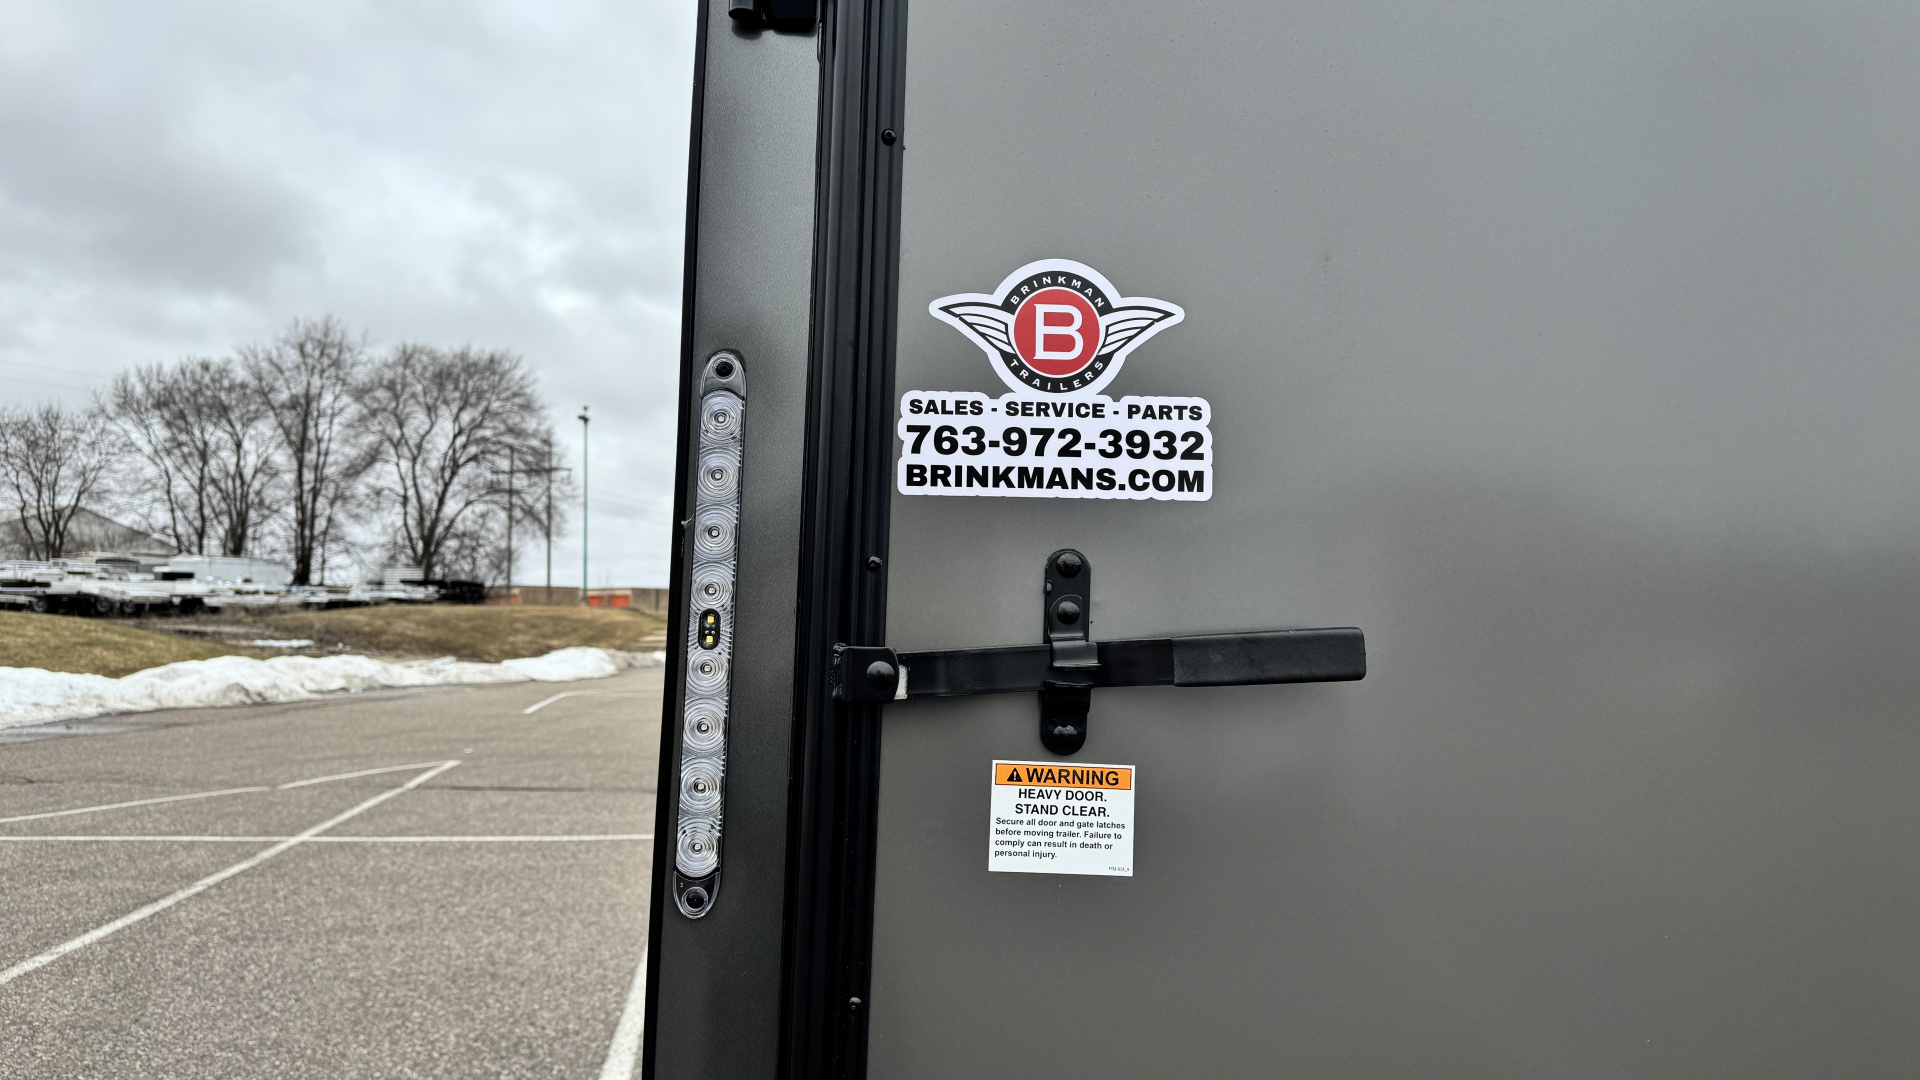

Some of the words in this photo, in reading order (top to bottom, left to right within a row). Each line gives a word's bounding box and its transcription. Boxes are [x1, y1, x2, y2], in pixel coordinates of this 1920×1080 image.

[1011, 275, 1105, 308] BRINKMAN
[1033, 303, 1083, 360] B
[1010, 359, 1104, 391] TRAILERS
[909, 398, 983, 416] SALES
[1005, 401, 1106, 418] SERVICE
[1127, 404, 1203, 421] PARTS
[906, 424, 1205, 460] 763-972-3932
[906, 463, 1205, 492] BRINKMANS.COM
[1026, 768, 1119, 786] WARNING
[1019, 788, 1061, 800] HEAVY
[1066, 790, 1107, 802] DOOR.
[1015, 804, 1058, 815] STAND
[1062, 806, 1109, 817] CLEAR.
[1077, 821, 1094, 829] gate
[995, 839, 1024, 847] comply
[1024, 830, 1053, 838] moving
[1084, 831, 1111, 839] Failure
[1032, 851, 1057, 859] injury.
